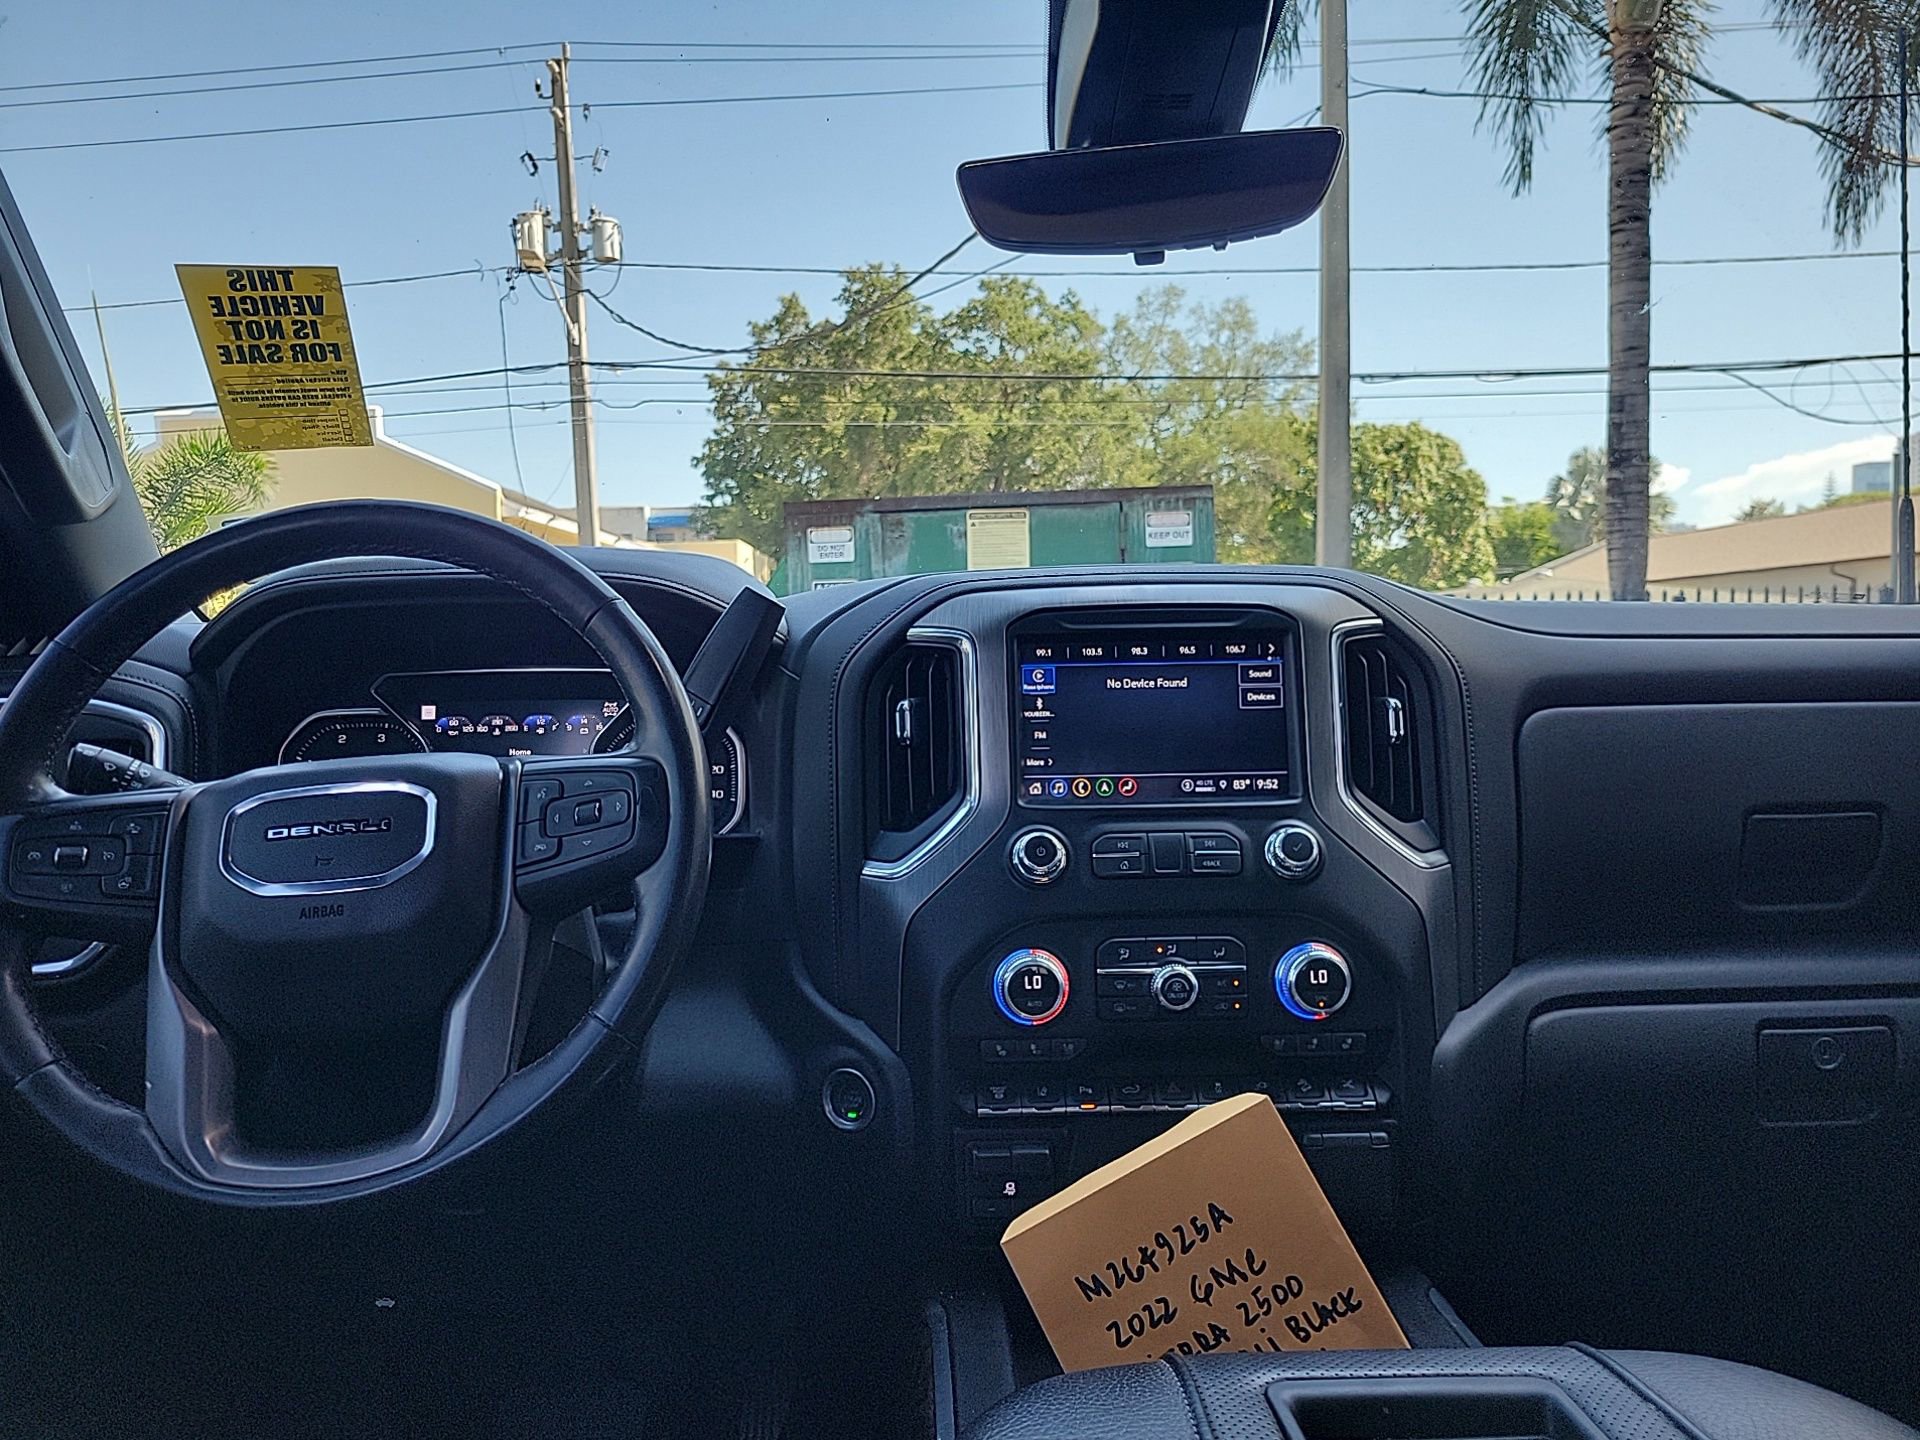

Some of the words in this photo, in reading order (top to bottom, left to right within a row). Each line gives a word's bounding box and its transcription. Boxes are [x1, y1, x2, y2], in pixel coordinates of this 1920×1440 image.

[1148, 531, 1170, 540] KEEP
[1171, 530, 1190, 539] OUT
[829, 544, 846, 552] NOT
[820, 551, 844, 560] ENTER
[1035, 648, 1052, 657] 99.1
[1082, 647, 1103, 656] 103.5
[1130, 646, 1148, 656] 98.3
[1179, 645, 1196, 655] 96.5
[1225, 644, 1246, 654] 106.7
[1248, 669, 1272, 678] Sound
[1106, 678, 1121, 689] No
[1122, 677, 1155, 689] Device
[1156, 677, 1188, 688] Found
[1246, 693, 1276, 702] Devices
[462, 724, 475, 733] 120
[523, 725, 529, 733] E
[337, 734, 347, 744] 2
[377, 733, 386, 743] 3
[1033, 731, 1047, 740] FM
[508, 748, 532, 756] Home
[1026, 758, 1045, 767] More
[1256, 778, 1279, 790] 9:52
[266, 818, 392, 839] DENALI
[299, 904, 344, 920] AIRBAG
[1310, 969, 1328, 984] LO
[1024, 975, 1042, 990] LO
[1106, 1296, 1178, 1348] 2022
[1190, 1248, 1267, 1307] GMC
[1236, 1275, 1304, 1327] 2500
[1283, 1287, 1363, 1343] BLACK
